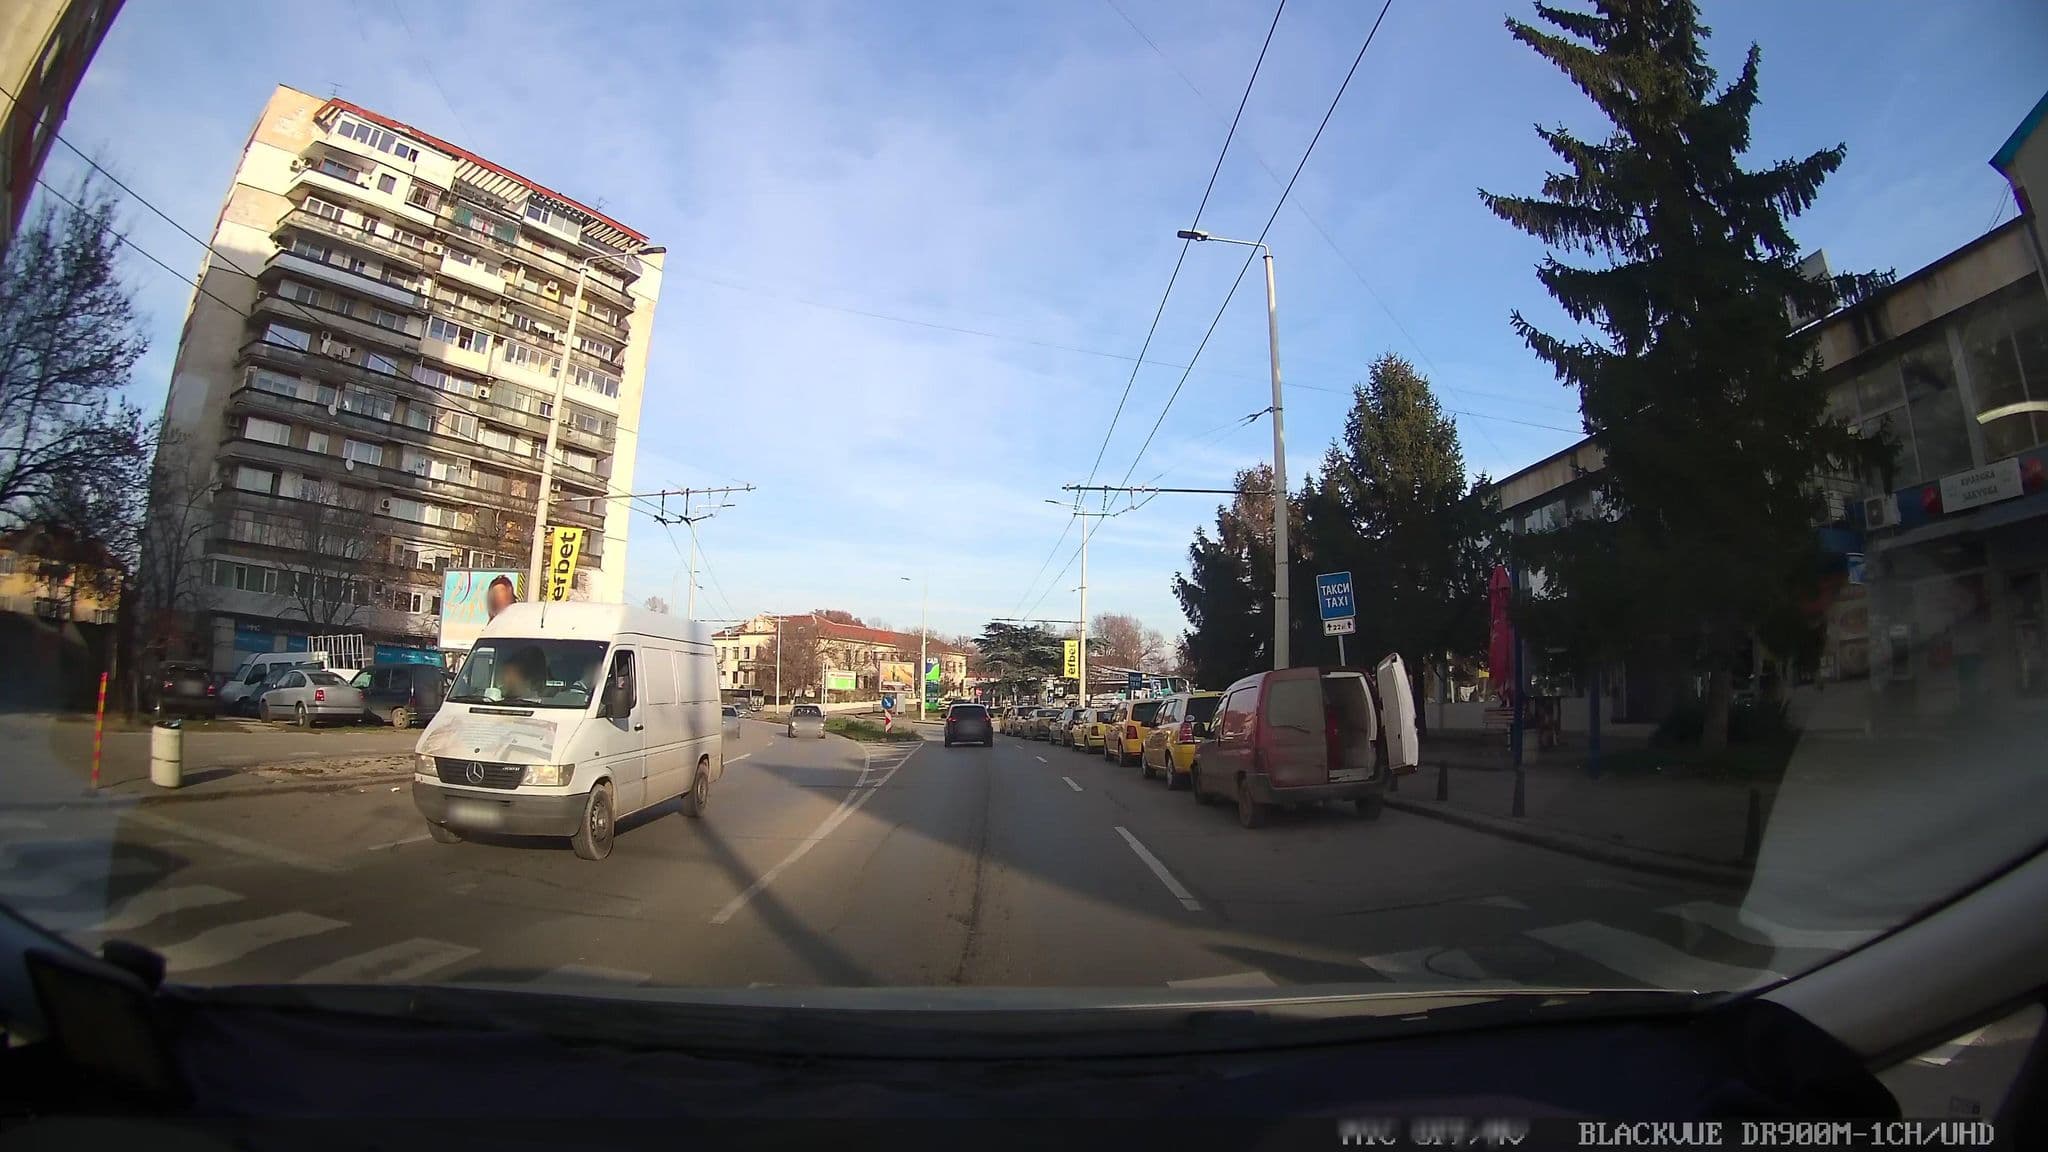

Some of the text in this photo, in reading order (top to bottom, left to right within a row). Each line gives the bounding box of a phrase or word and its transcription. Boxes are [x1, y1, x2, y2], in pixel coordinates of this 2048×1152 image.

[553, 532, 576, 601] efbet
[1320, 583, 1350, 596] ТАКСИ
[1325, 596, 1348, 608] TAXI
